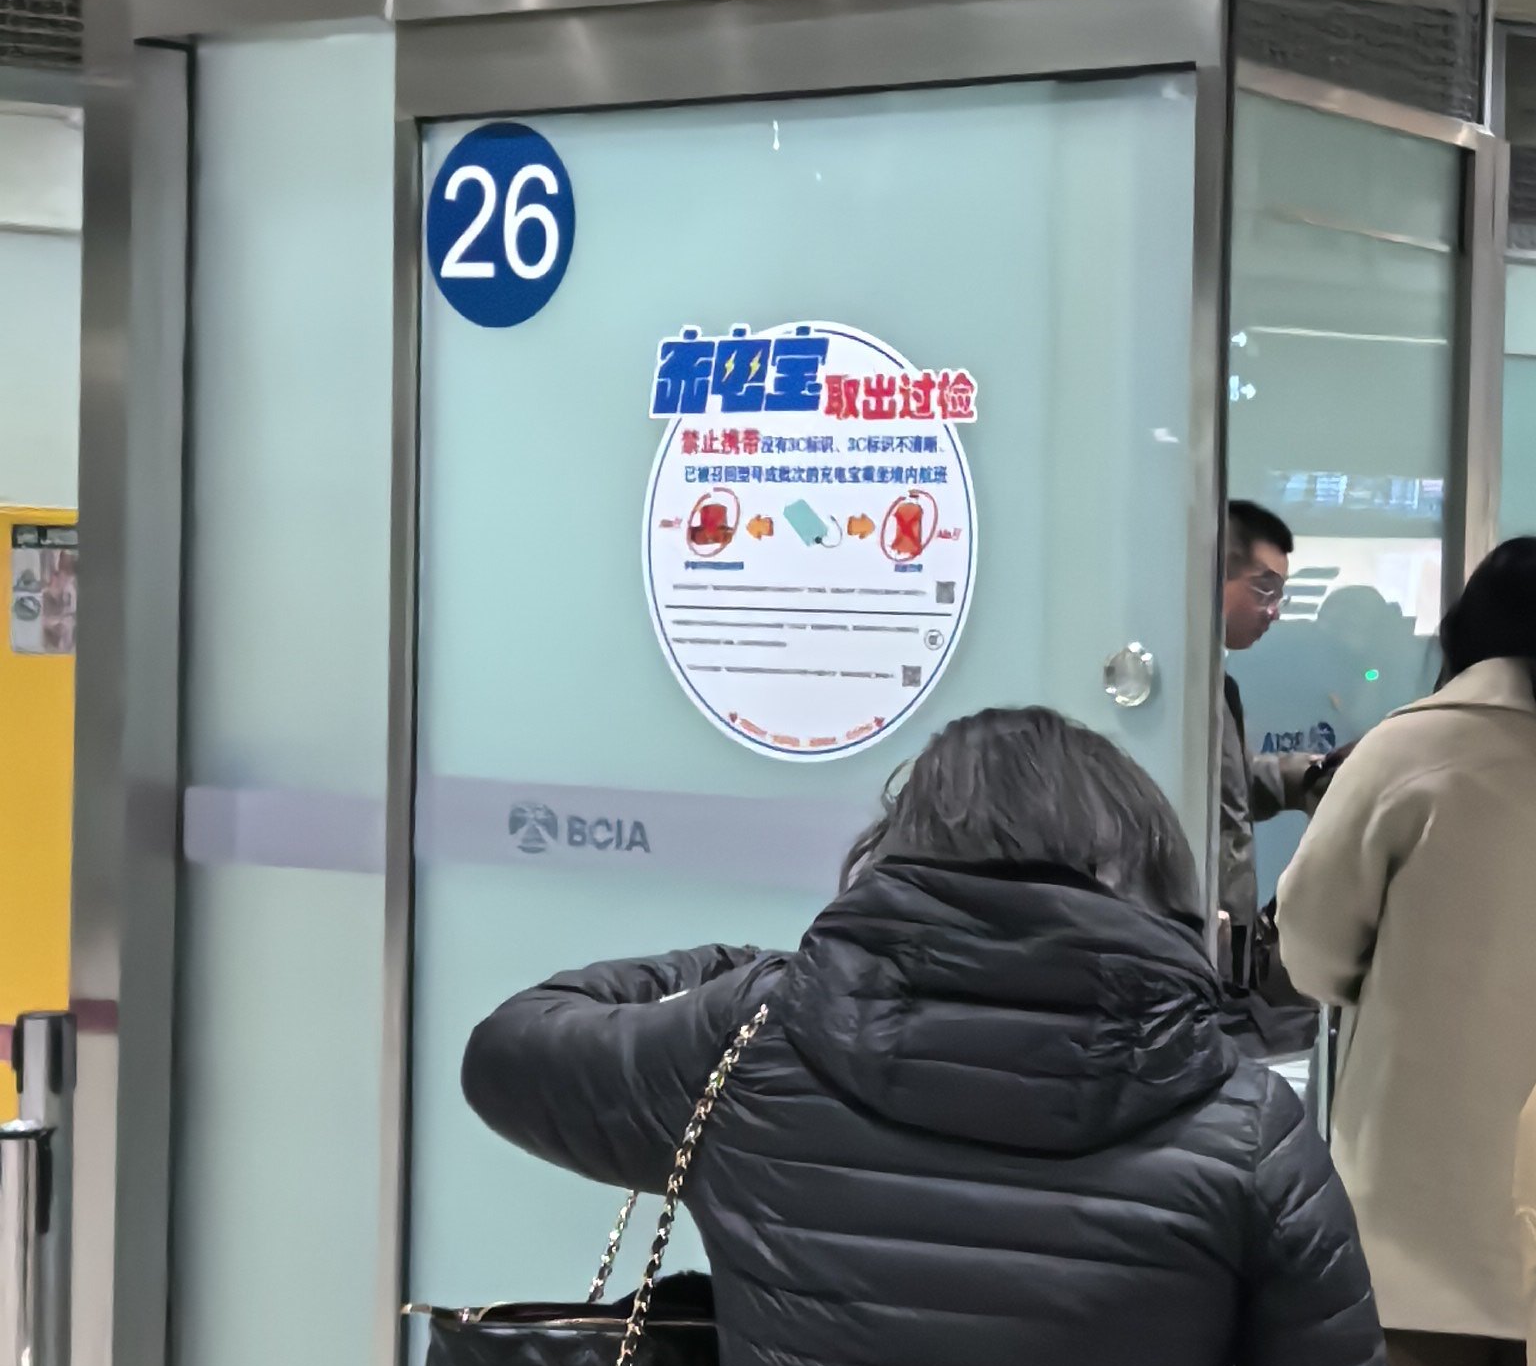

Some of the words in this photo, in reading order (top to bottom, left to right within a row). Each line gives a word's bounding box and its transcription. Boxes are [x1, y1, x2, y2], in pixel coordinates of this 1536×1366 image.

[440, 164, 559, 280] 26
[652, 325, 829, 414] 充电宝
[824, 372, 975, 420] 取出过检
[567, 816, 651, 853] BCIA
